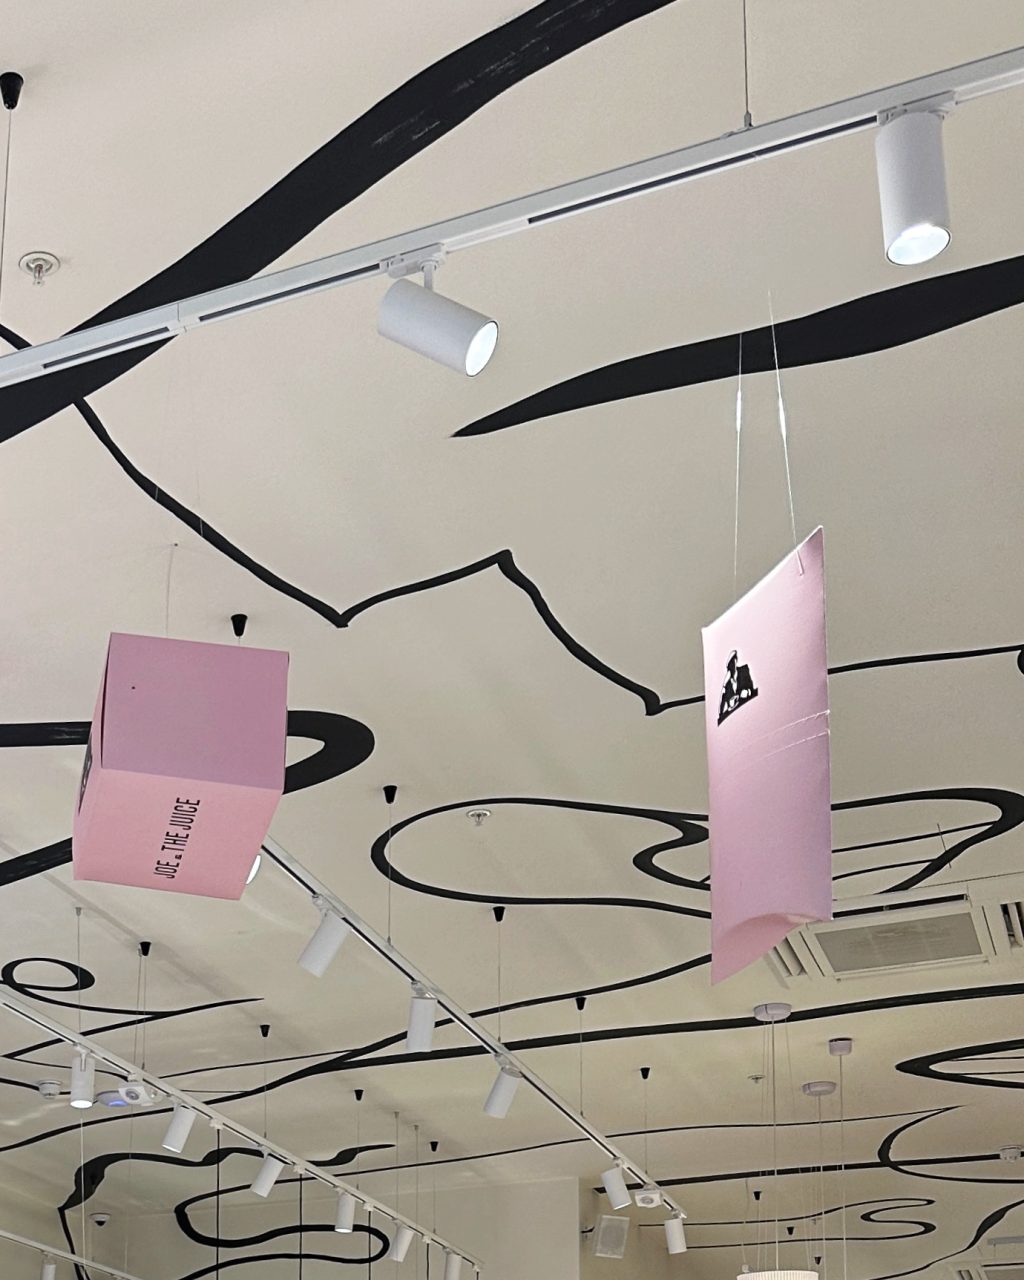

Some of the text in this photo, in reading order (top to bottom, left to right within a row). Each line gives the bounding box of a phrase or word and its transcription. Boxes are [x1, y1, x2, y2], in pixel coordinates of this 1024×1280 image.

[169, 797, 201, 830] JUICE
[161, 831, 190, 852] THE
[153, 860, 180, 879] JOE
